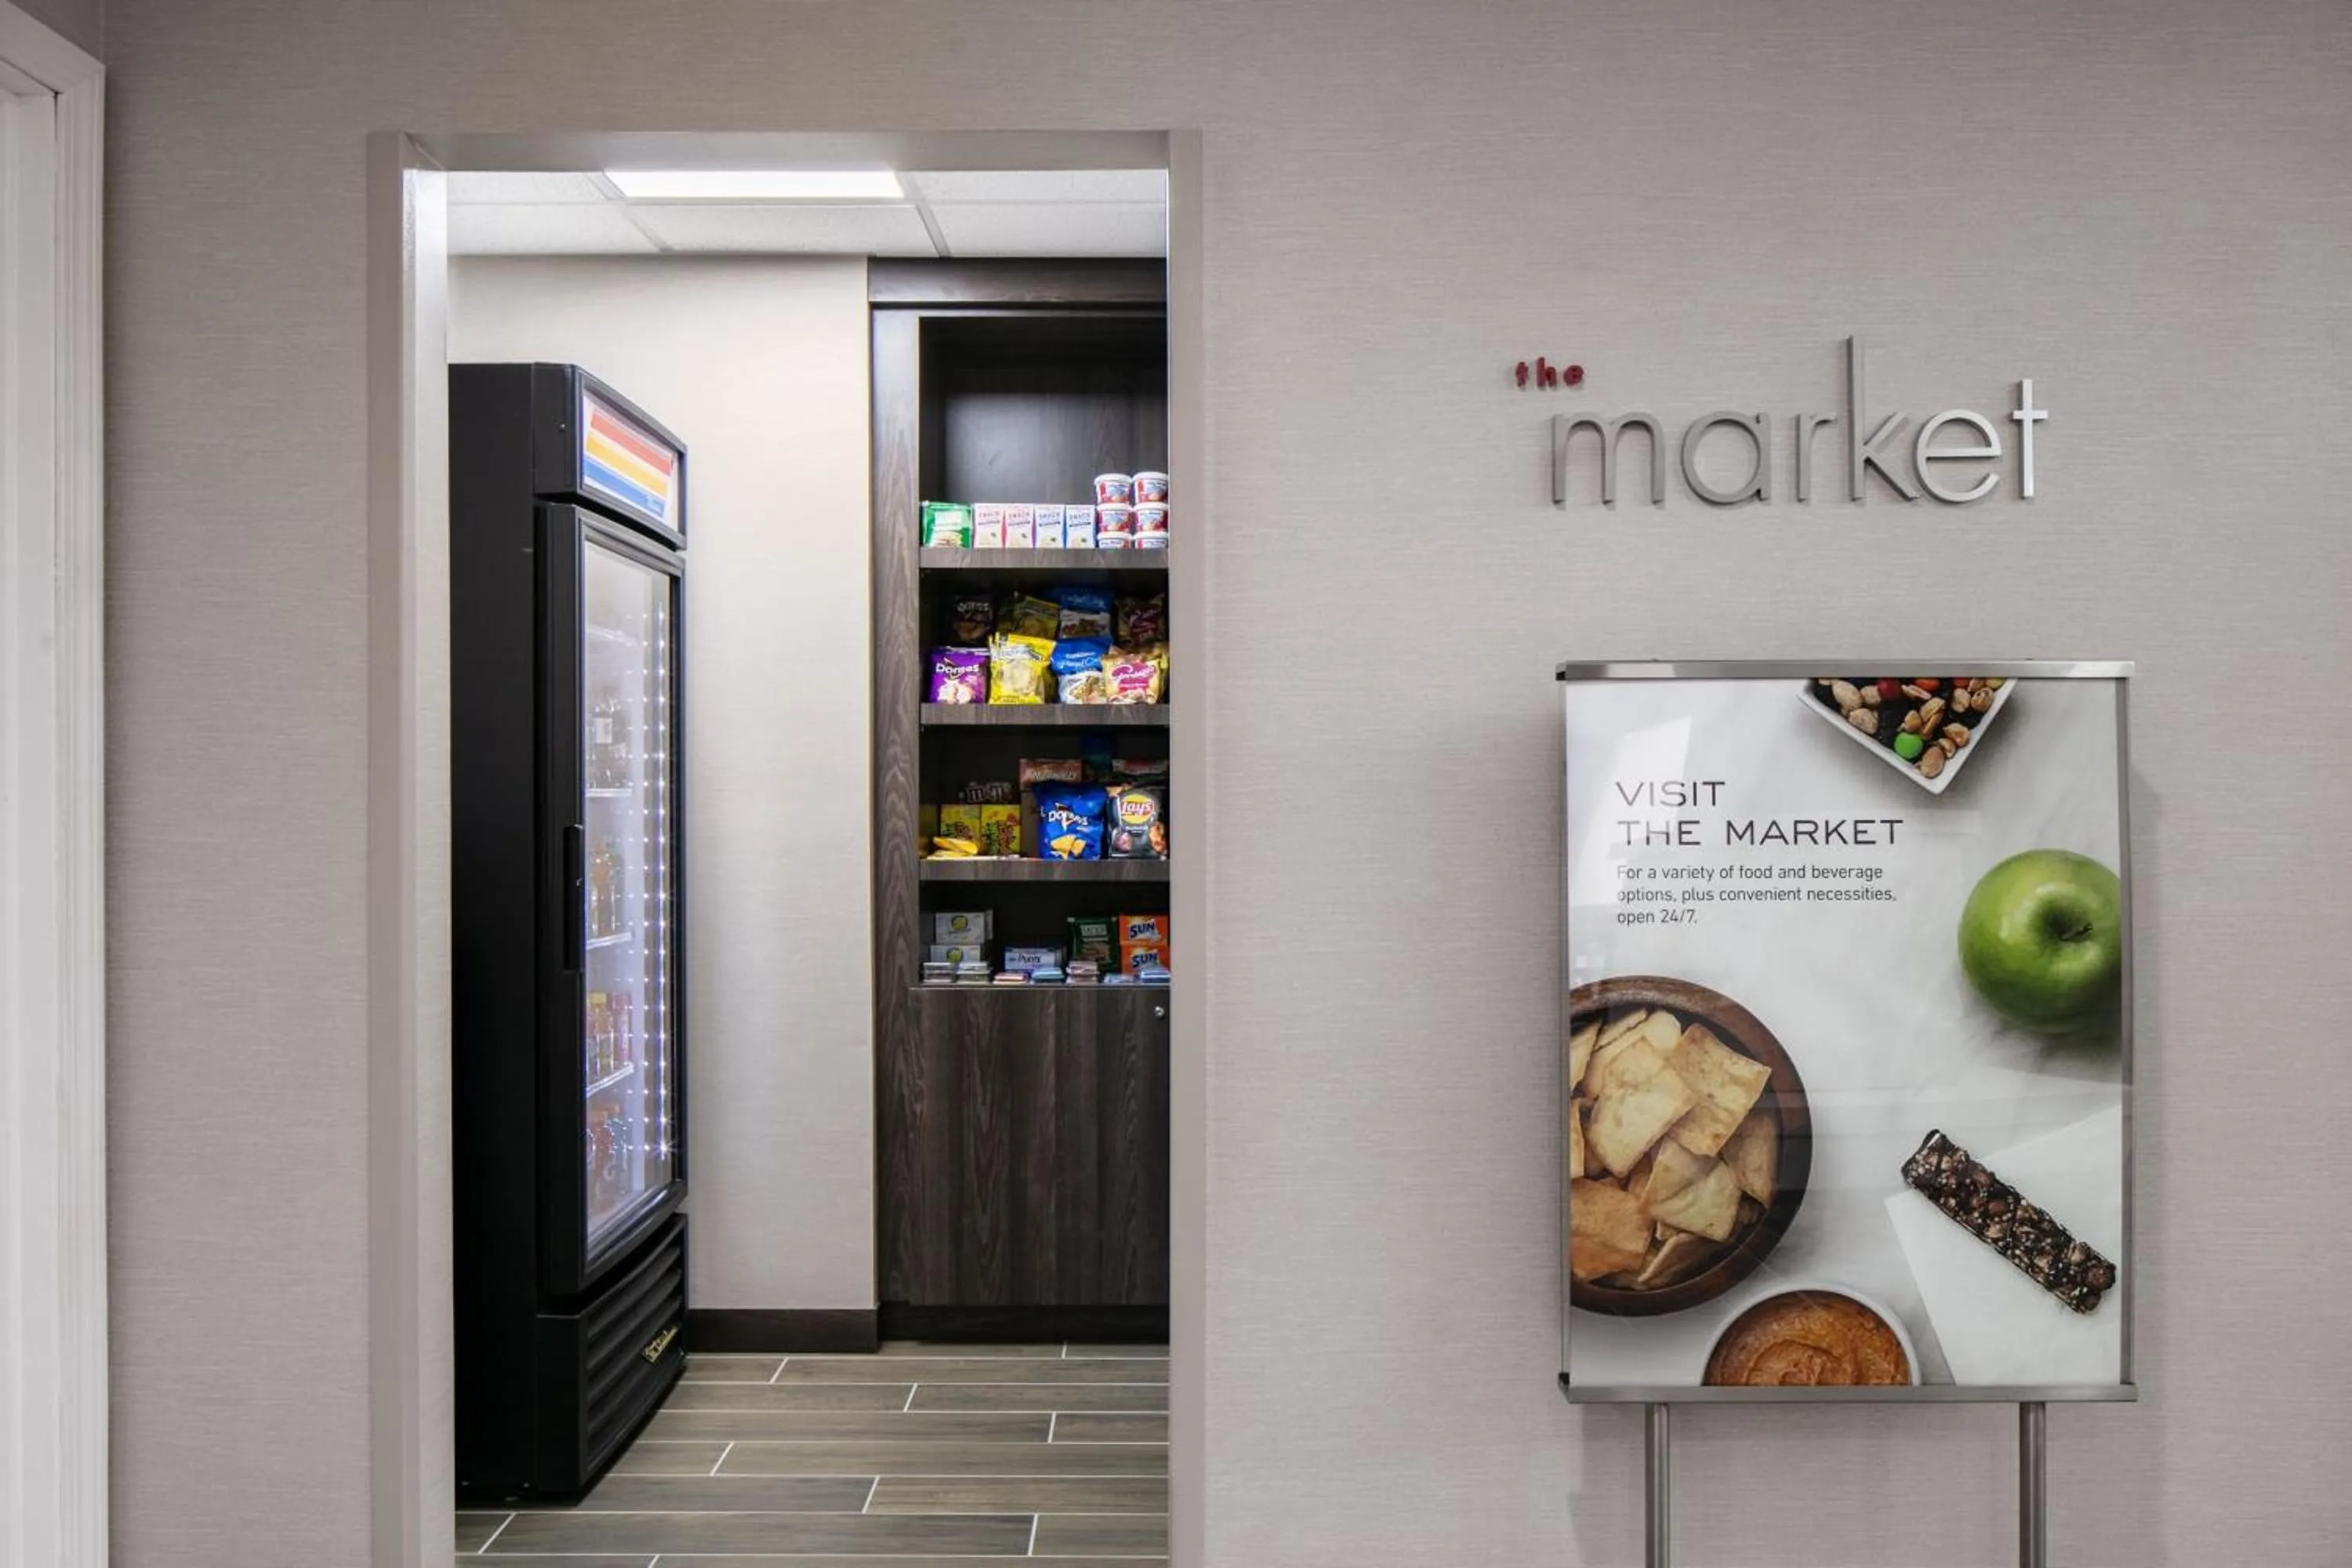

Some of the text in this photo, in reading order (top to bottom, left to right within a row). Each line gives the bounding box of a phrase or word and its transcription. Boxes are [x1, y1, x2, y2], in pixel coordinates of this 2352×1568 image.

[1515, 357, 1584, 387] the
[1552, 335, 2049, 505] market
[1616, 782, 1726, 807] VISIT
[1617, 819, 1904, 846] THE MARKET
[1617, 865, 1883, 883] For a variety of food and beverage
[1617, 886, 1897, 904] options, plus convenient necessities,
[1617, 909, 1698, 926] open 24/7.
[1130, 921, 1156, 938] SUN
[1132, 952, 1158, 967] SUN
